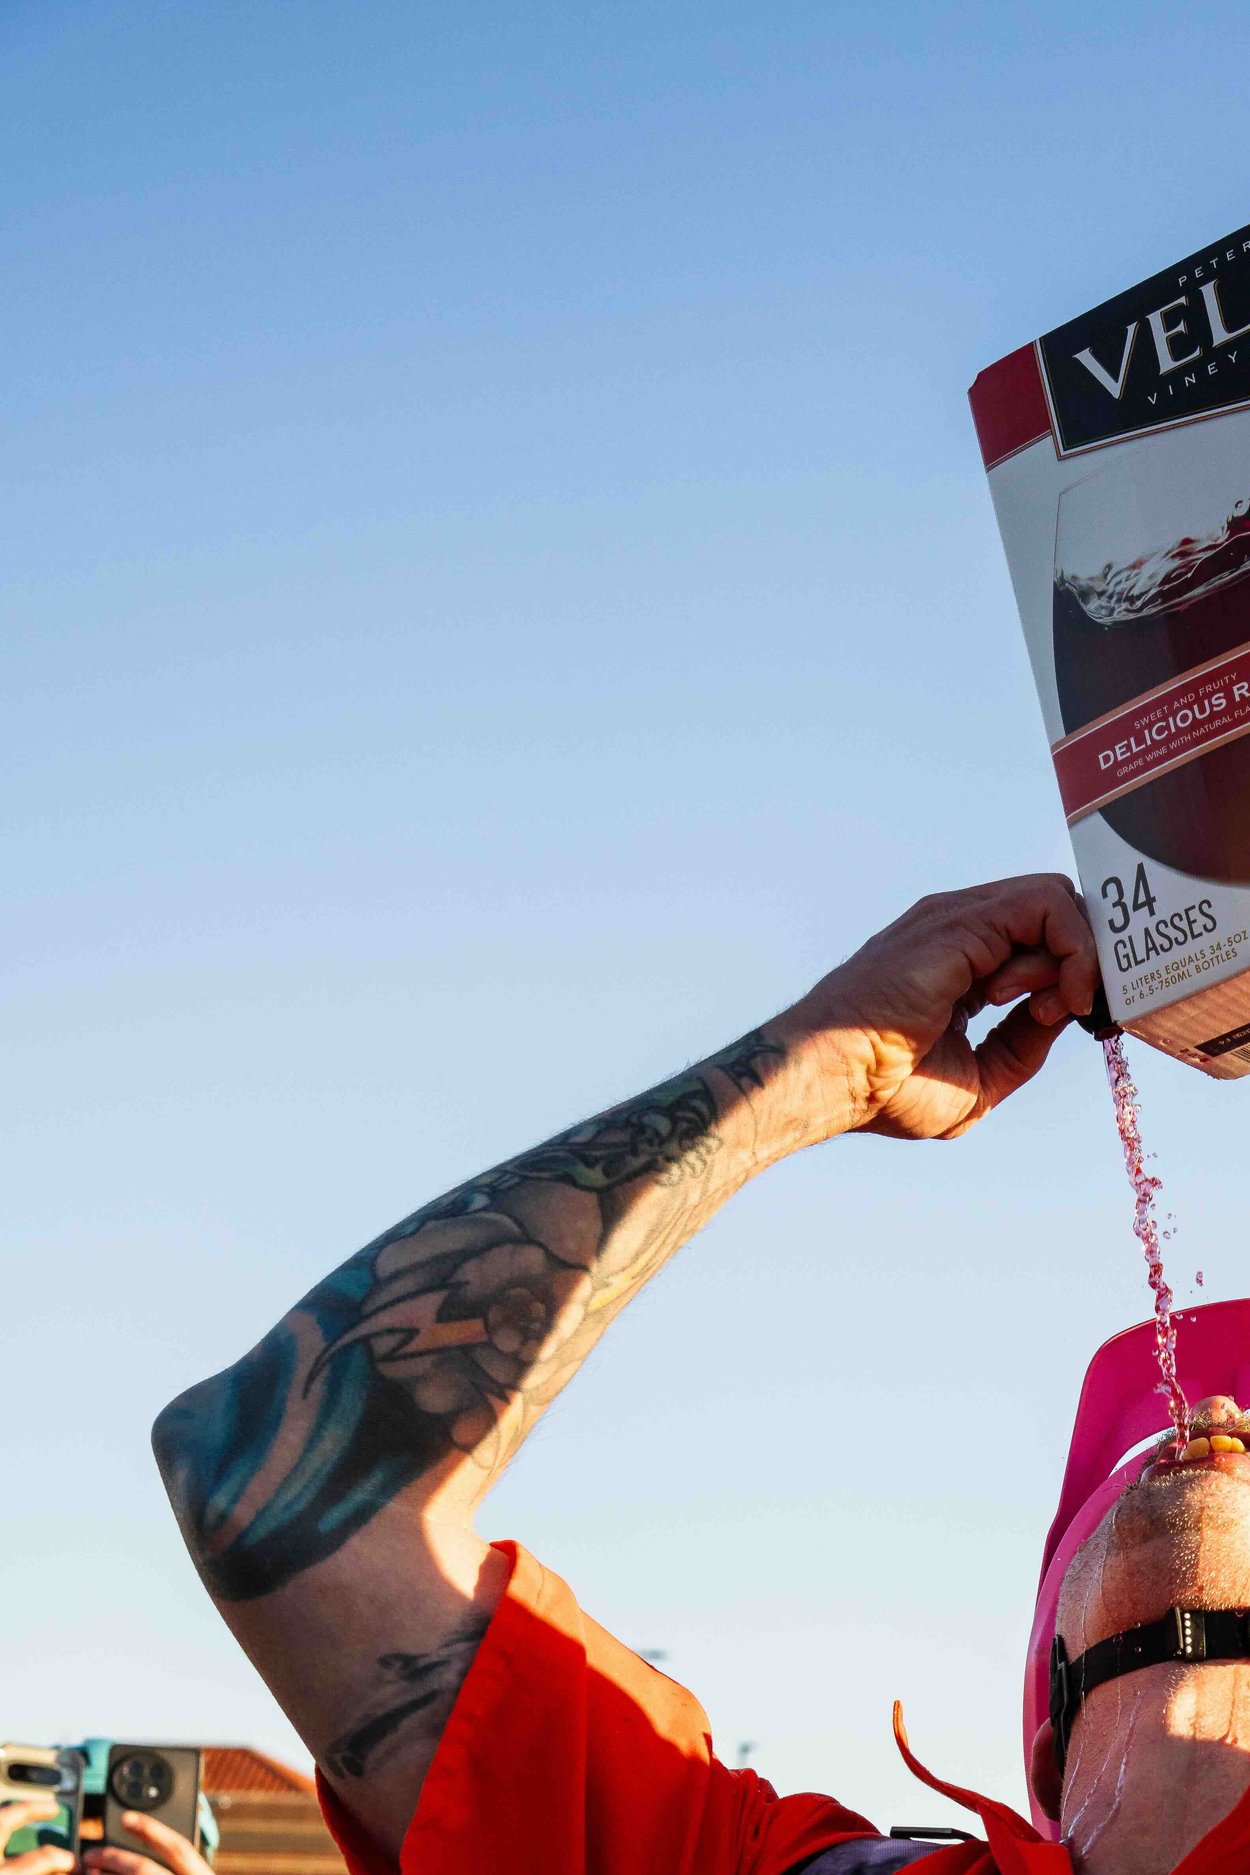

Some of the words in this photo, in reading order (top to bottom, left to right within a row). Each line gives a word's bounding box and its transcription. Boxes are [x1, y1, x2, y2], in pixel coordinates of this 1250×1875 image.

[1098, 692, 1227, 770] DELICIOUS
[1134, 706, 1169, 730] SWEET
[1173, 693, 1195, 709] AND
[1199, 672, 1238, 697] FRUITY
[1116, 759, 1145, 777] GRAPE
[1145, 746, 1168, 763] WINE
[1169, 734, 1191, 751] WITH
[1192, 714, 1234, 739] NATURAL
[1101, 861, 1157, 934] 34
[1113, 899, 1217, 973] GLASSES
[1121, 984, 1128, 995] 5
[1131, 970, 1162, 991] LITERS
[1165, 950, 1206, 975] EQUALS
[1125, 995, 1136, 1006] or
[1139, 970, 1193, 1000] 6.5-750ML
[1195, 948, 1238, 973] BOTTLES
